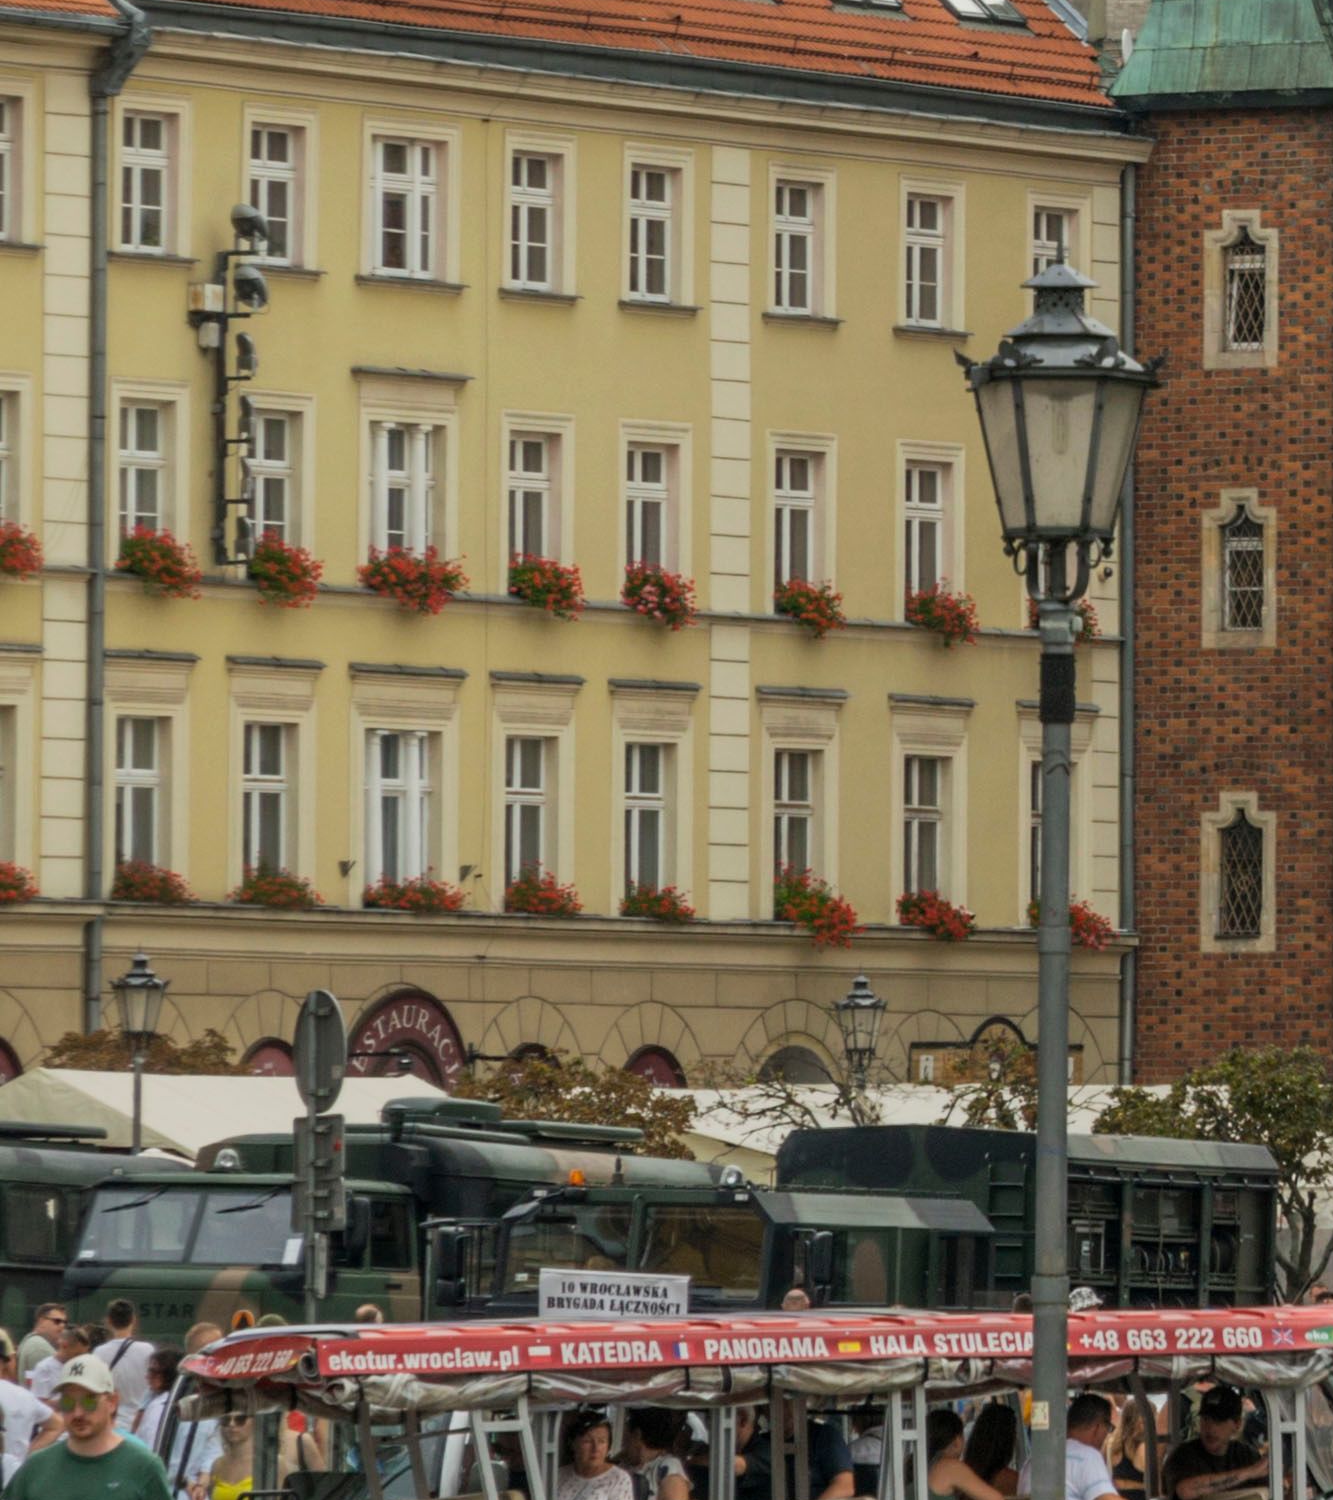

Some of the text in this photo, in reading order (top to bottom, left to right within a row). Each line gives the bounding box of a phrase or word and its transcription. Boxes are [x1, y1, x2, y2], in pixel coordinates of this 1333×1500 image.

[561, 1281, 575, 1294] 10
[139, 1303, 195, 1320] STAR
[547, 1296, 605, 1311] BRYGADA
[328, 1326, 1263, 1371] ekotur.wroclaw.pl KATEDRA PANORAMA HALA STULECIA +48 663 222 660
